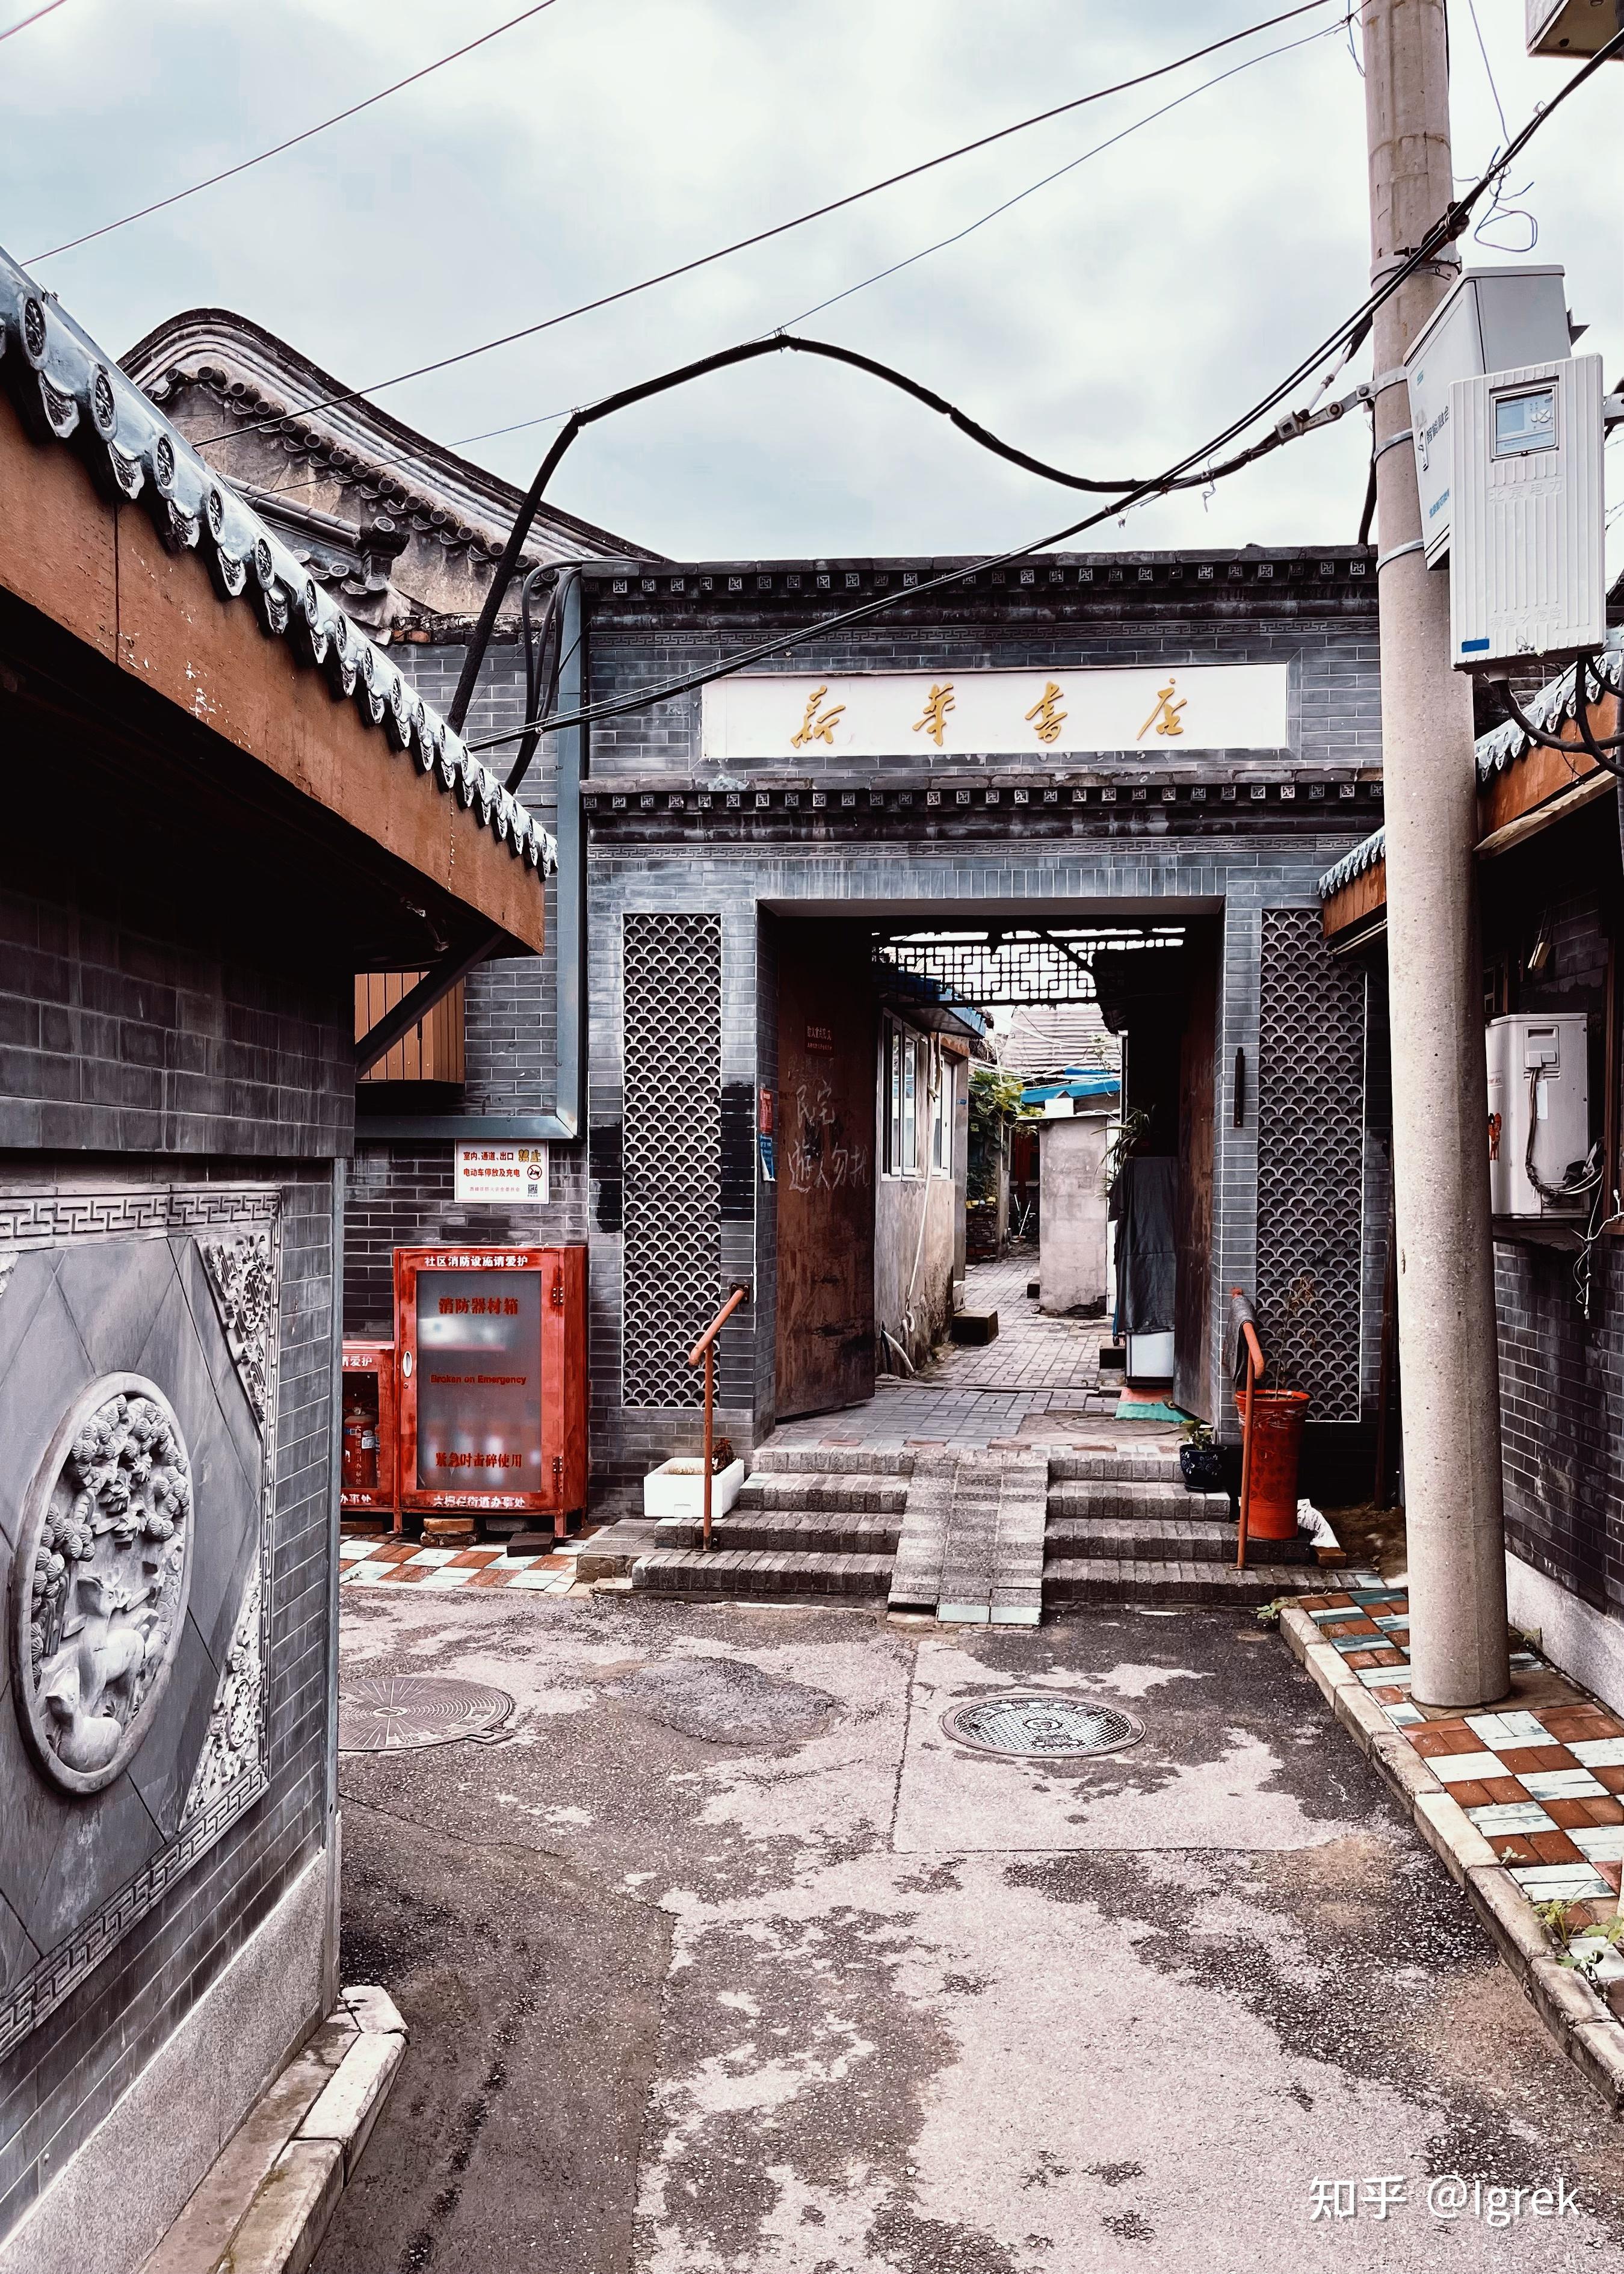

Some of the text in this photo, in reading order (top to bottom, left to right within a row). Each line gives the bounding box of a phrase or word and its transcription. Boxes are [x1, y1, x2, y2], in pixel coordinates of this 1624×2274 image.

[1488, 480, 1564, 503] 北京电力
[518, 1149, 542, 1163] 禁止
[463, 1168, 520, 1178] 电动车停放及充电
[424, 1255, 528, 1267] 社区消防设施请爱护
[438, 1297, 519, 1315] 消防器材箱
[431, 1374, 462, 1383] Broken
[477, 1374, 526, 1385] Emergency
[436, 1452, 522, 1468] 紧急时击碎使用
